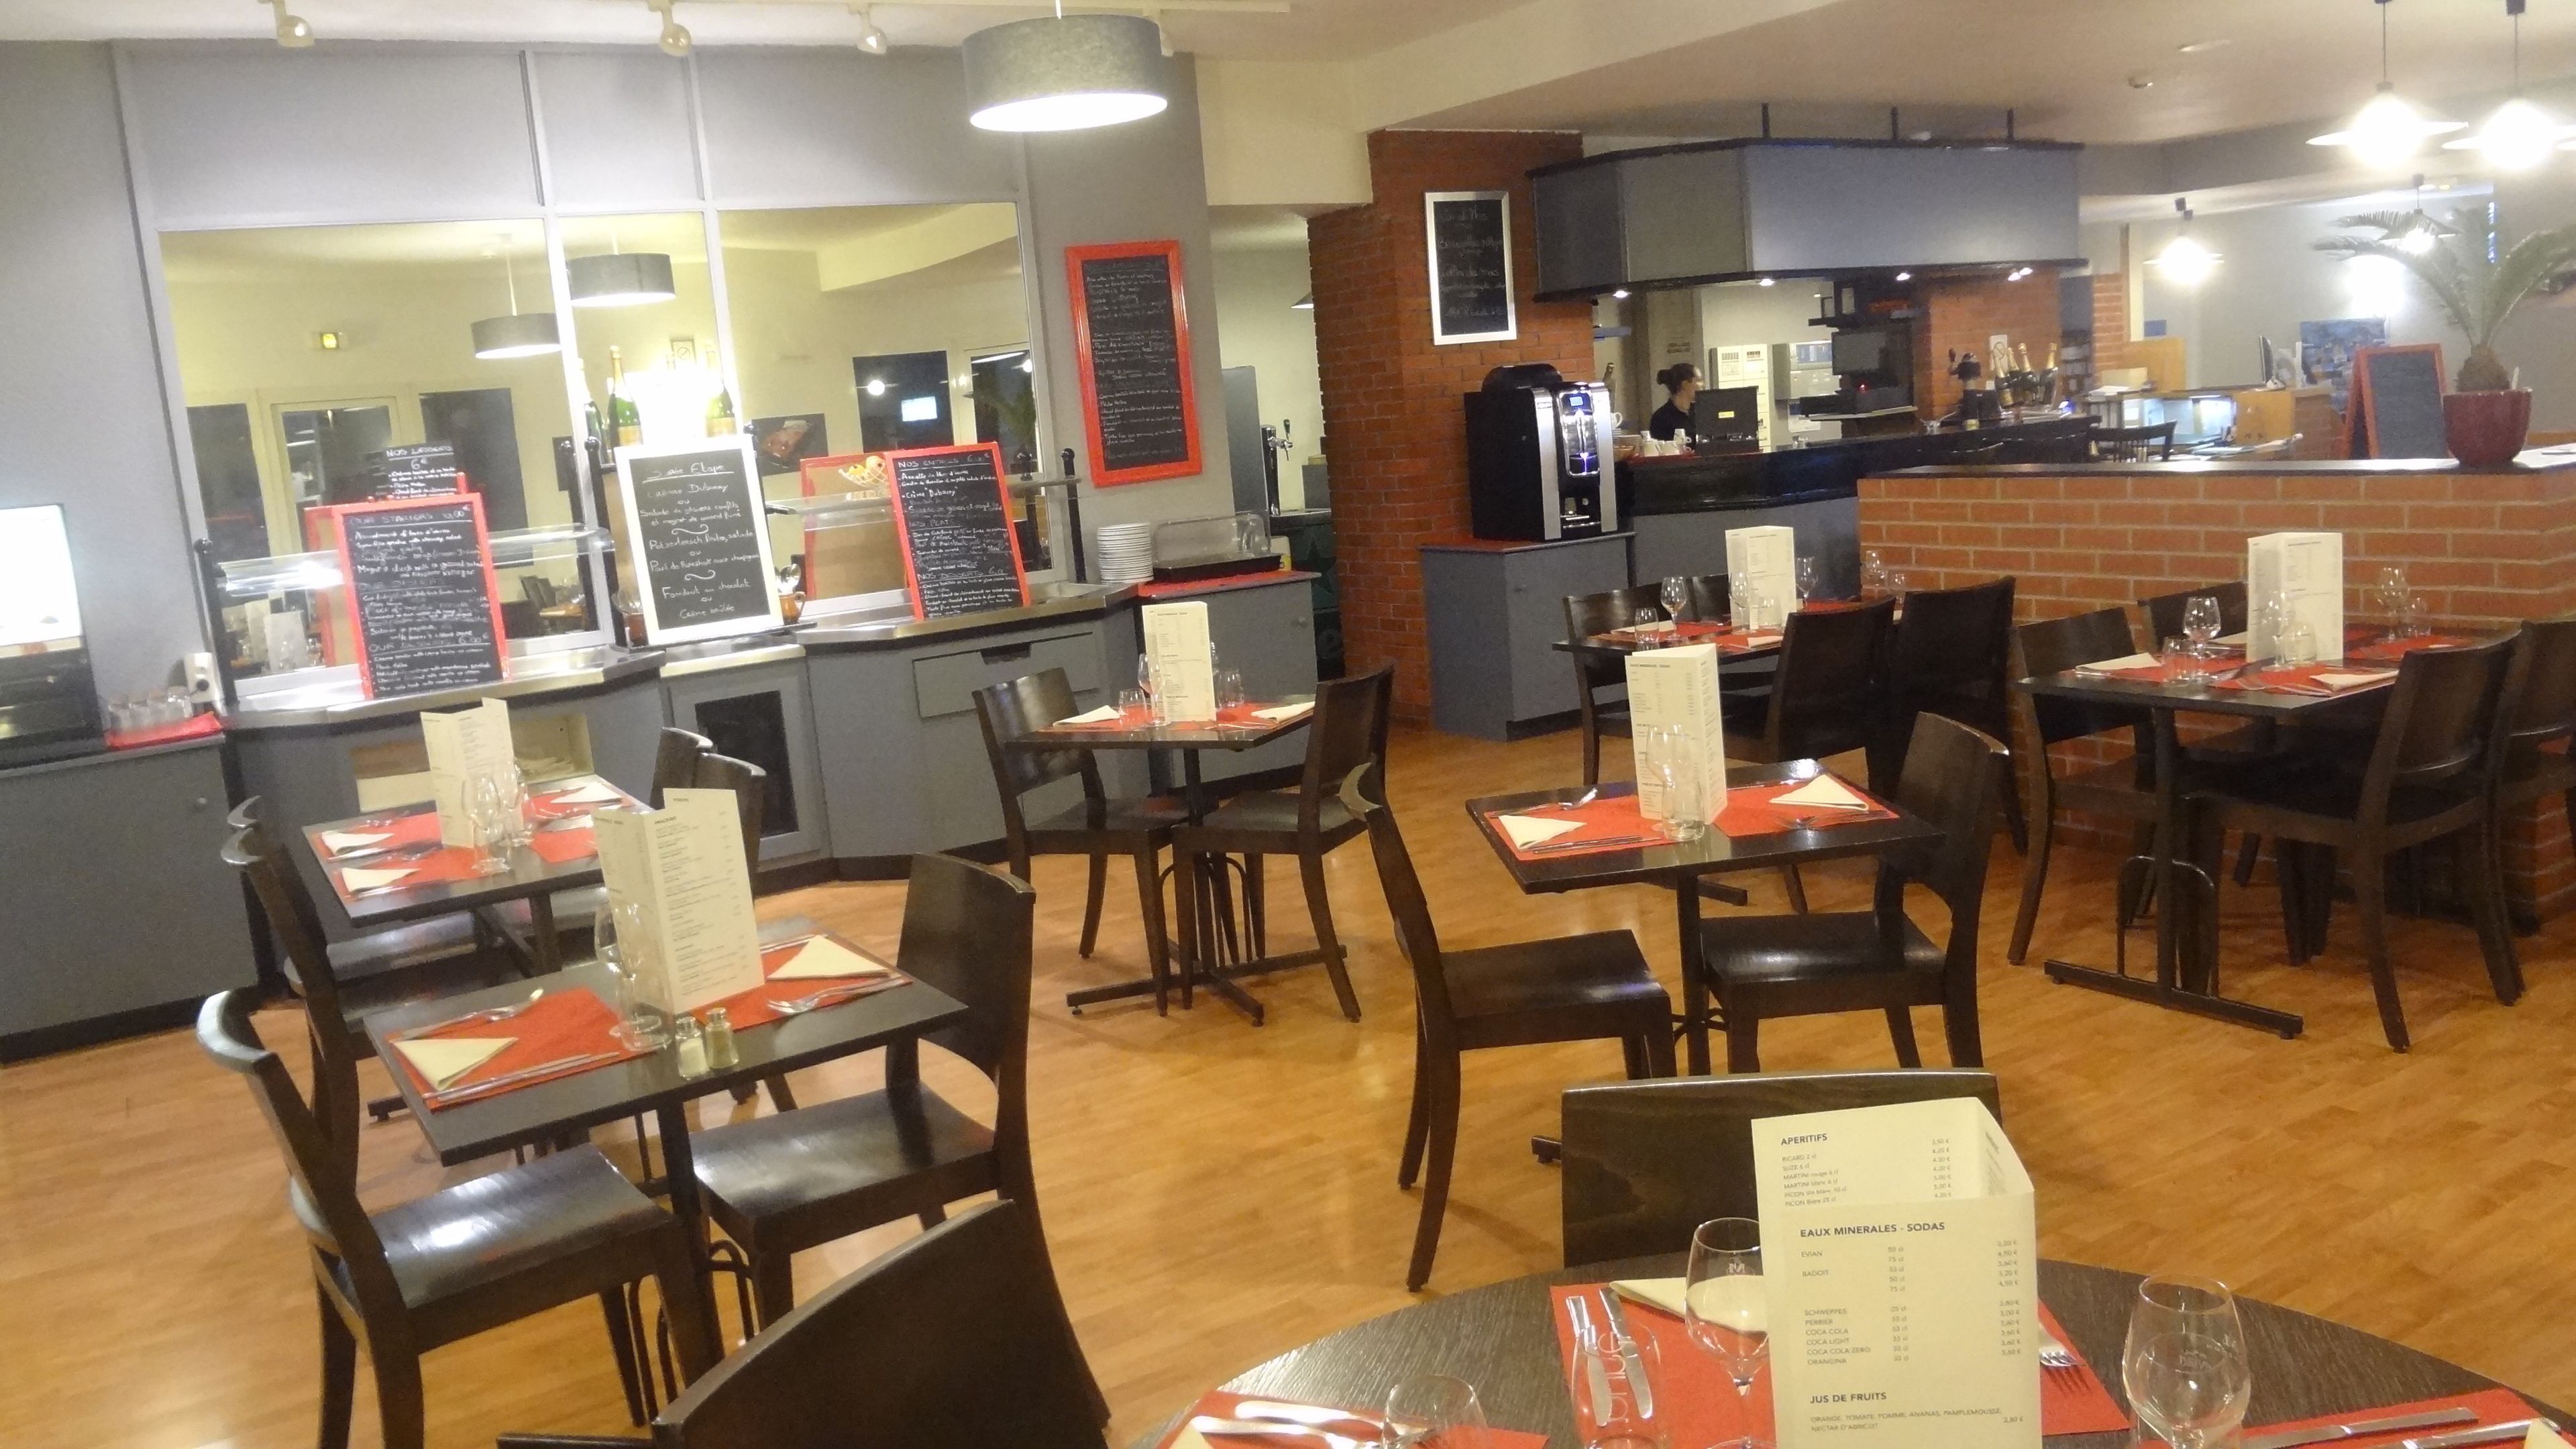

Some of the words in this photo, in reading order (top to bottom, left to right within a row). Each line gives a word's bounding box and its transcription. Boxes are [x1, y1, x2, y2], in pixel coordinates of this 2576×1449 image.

[691, 462, 724, 474] Etape
[918, 573, 936, 581] NOS
[662, 586, 700, 598] Fondant
[719, 578, 751, 590] chocolat
[1781, 1134, 1827, 1145] APERITIFS
[1801, 1228, 1830, 1237] EAUX
[1835, 1224, 1896, 1236] MINERALES
[1907, 1222, 1945, 1232] SODAS
[1810, 1395, 1829, 1403] JUS
[1851, 1392, 1886, 1401] FRUITS
